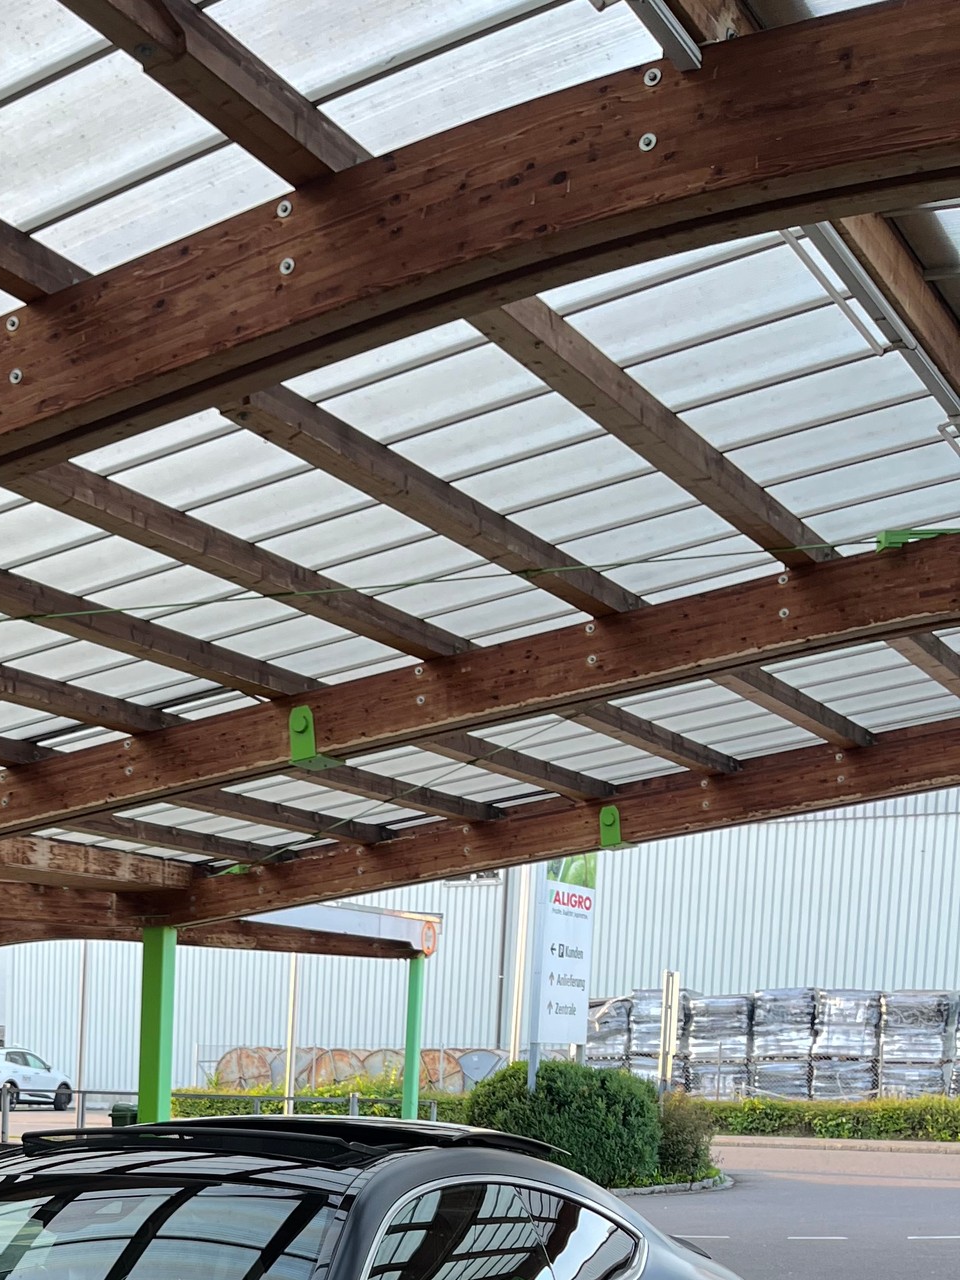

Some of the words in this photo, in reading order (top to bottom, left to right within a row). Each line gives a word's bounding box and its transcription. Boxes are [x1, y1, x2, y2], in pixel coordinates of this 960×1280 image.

[552, 889, 592, 911] ALIGRO
[565, 945, 584, 959] Kunden
[556, 973, 586, 991] Anlieferung
[555, 1002, 577, 1016] Zentrale
